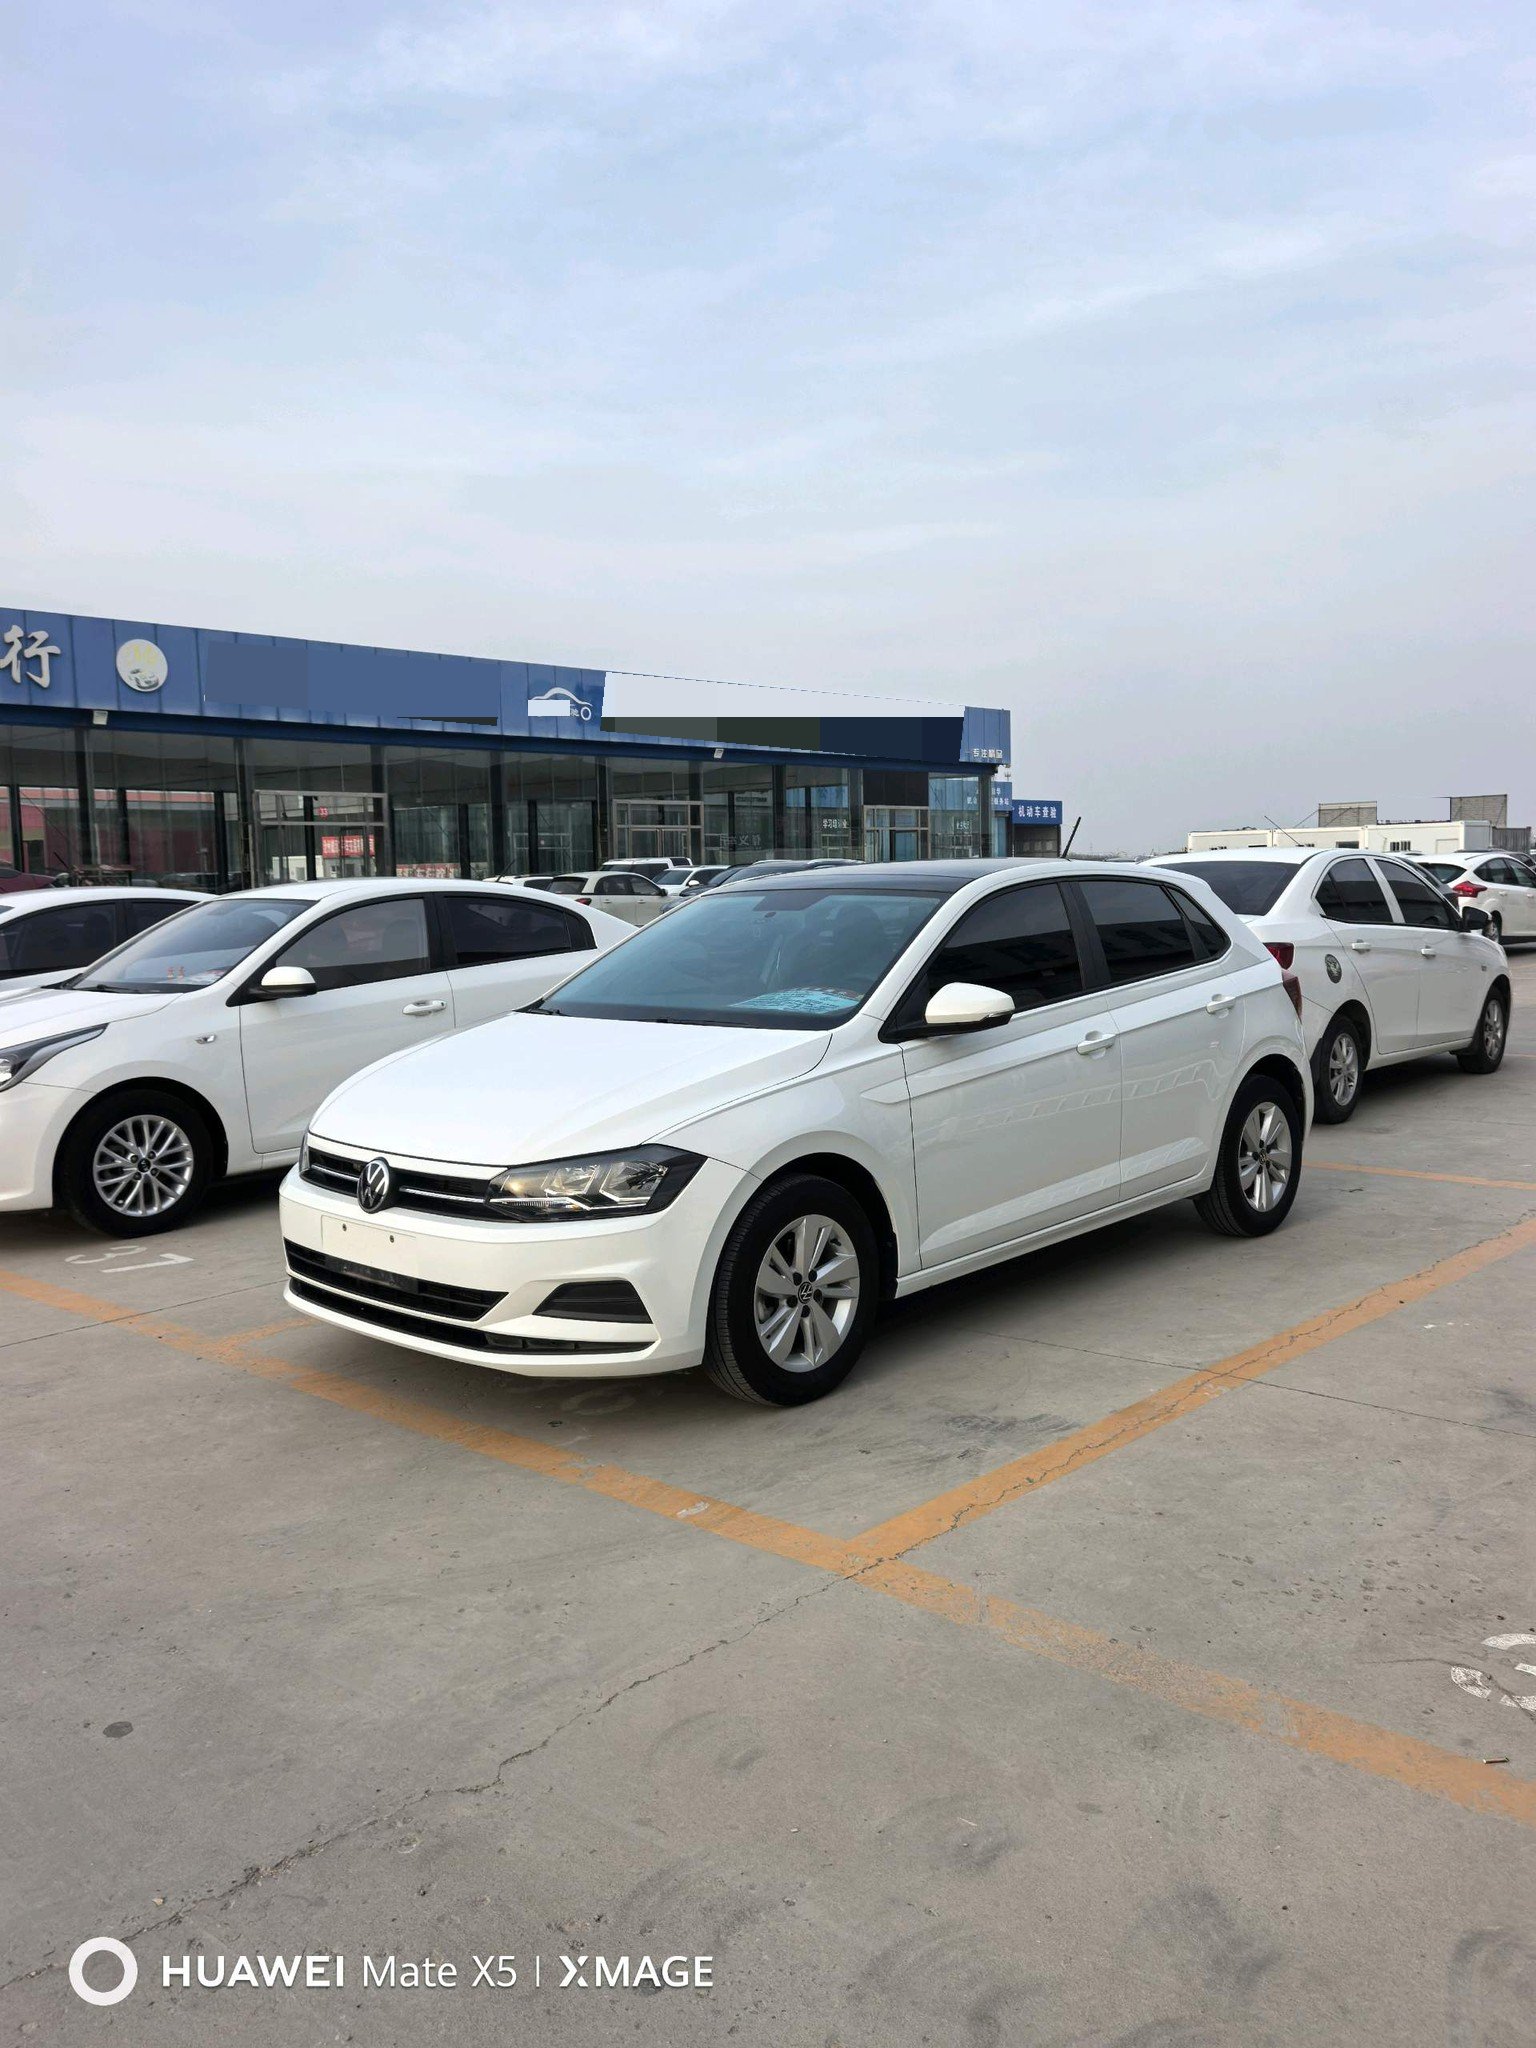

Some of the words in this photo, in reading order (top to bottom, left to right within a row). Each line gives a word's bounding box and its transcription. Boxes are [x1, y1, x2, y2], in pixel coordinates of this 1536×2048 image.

[0, 625, 61, 688] 行
[1018, 805, 1057, 818] 机动车查验
